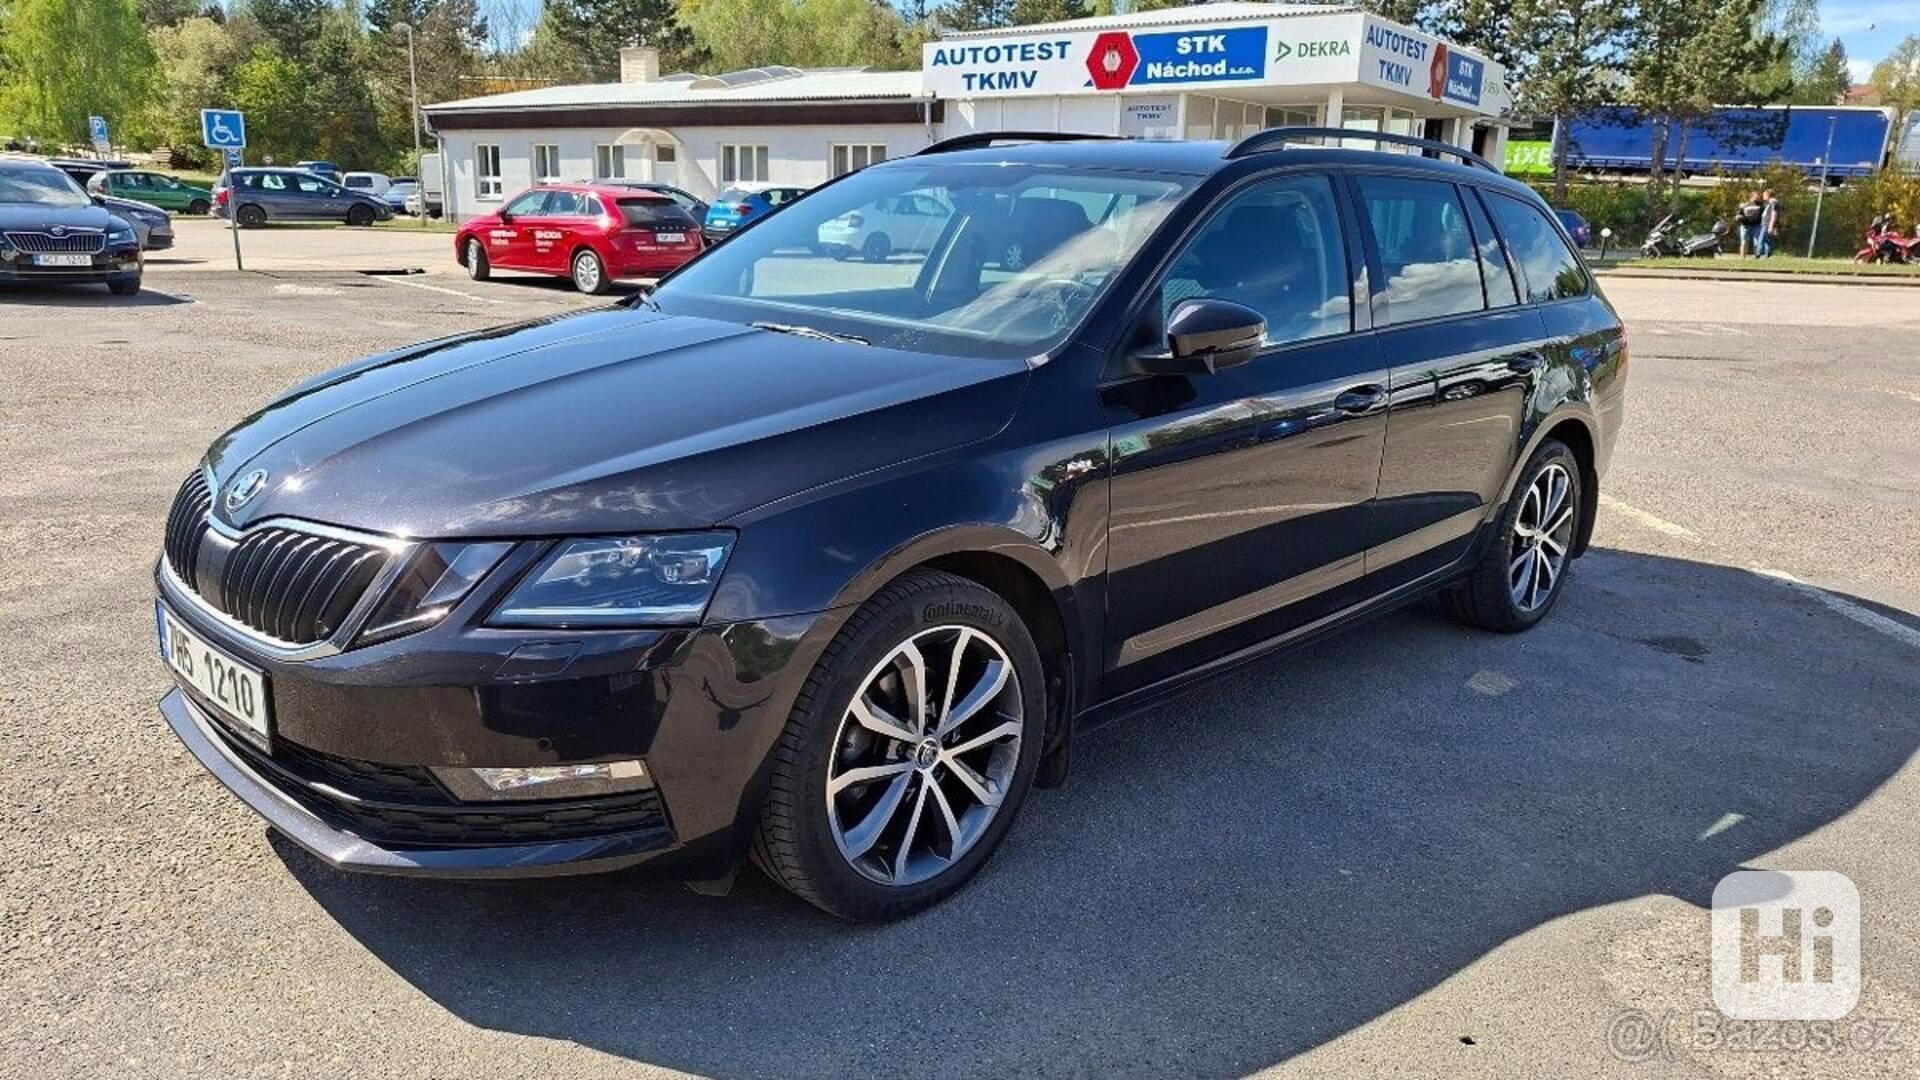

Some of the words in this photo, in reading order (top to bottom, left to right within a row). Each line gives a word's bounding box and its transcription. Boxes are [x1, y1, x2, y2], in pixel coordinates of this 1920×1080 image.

[1176, 35, 1226, 54] STK
[1297, 40, 1350, 58] DEKRA
[1366, 24, 1428, 62] AUTOTEST
[932, 41, 1072, 67] AUTOTEST
[1147, 60, 1226, 78] Náchod
[1378, 59, 1412, 86] TKMV
[962, 70, 1038, 91] TKMV
[1127, 104, 1172, 112] AUTOTEST
[923, 602, 995, 623] Continental
[204, 651, 255, 719] 1210
